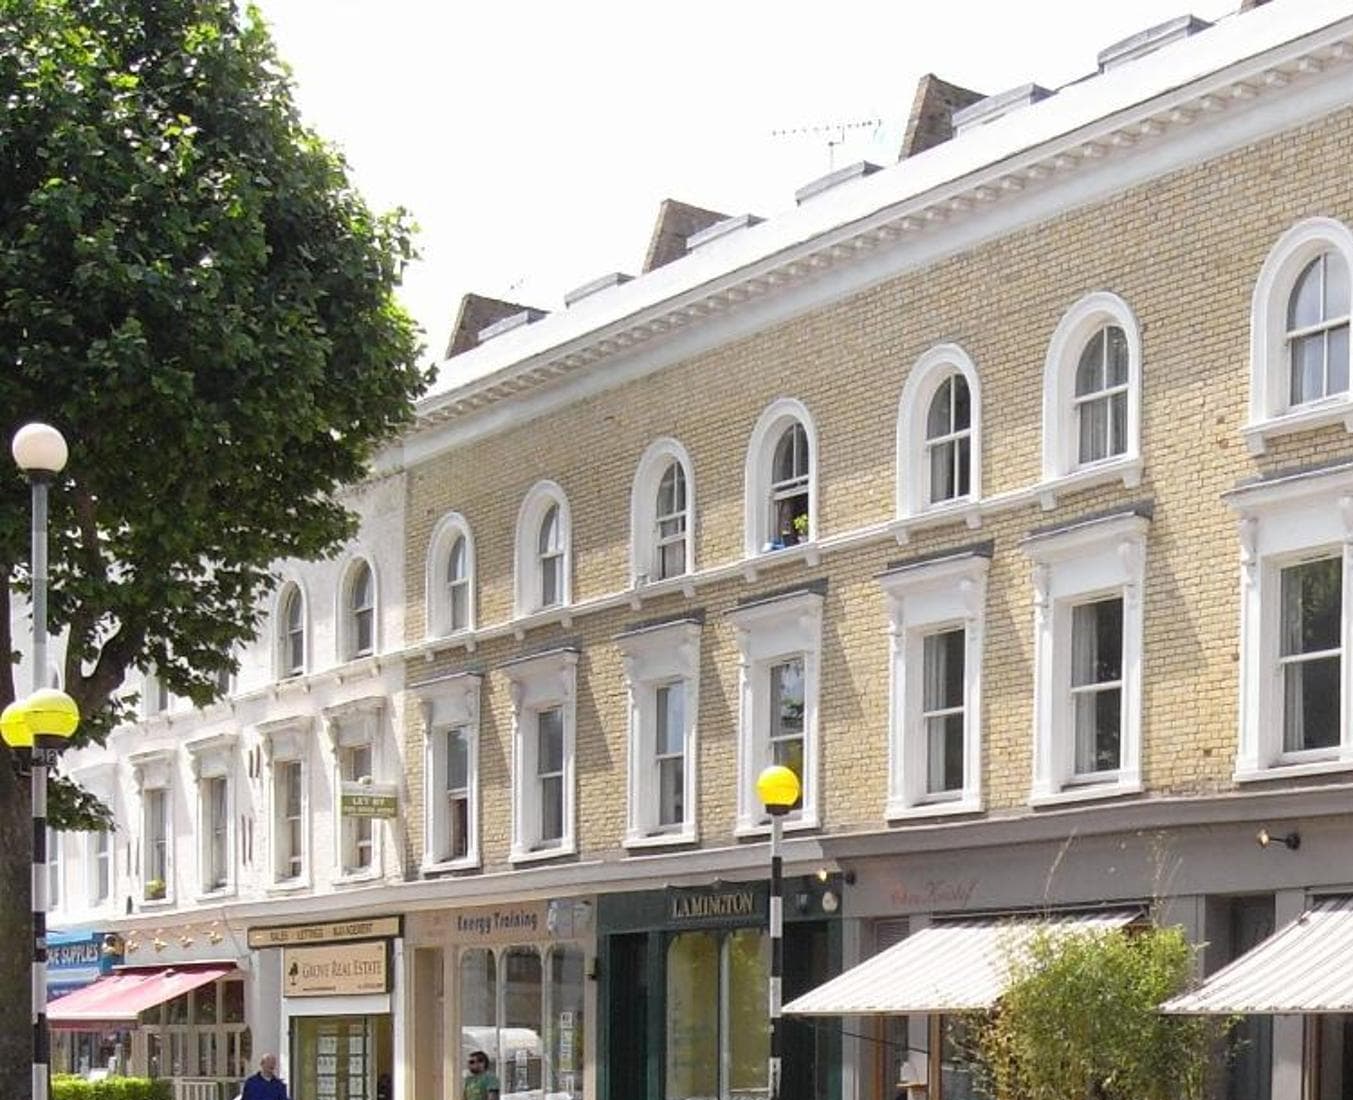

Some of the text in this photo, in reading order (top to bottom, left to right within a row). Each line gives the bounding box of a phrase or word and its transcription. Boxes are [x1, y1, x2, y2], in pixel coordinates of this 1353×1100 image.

[673, 894, 754, 917] LAMINGTON
[457, 909, 537, 934] Energy Training
[61, 943, 98, 965] SUPPLIES
[331, 960, 351, 976] REAL
[354, 959, 382, 975] ESTATE
